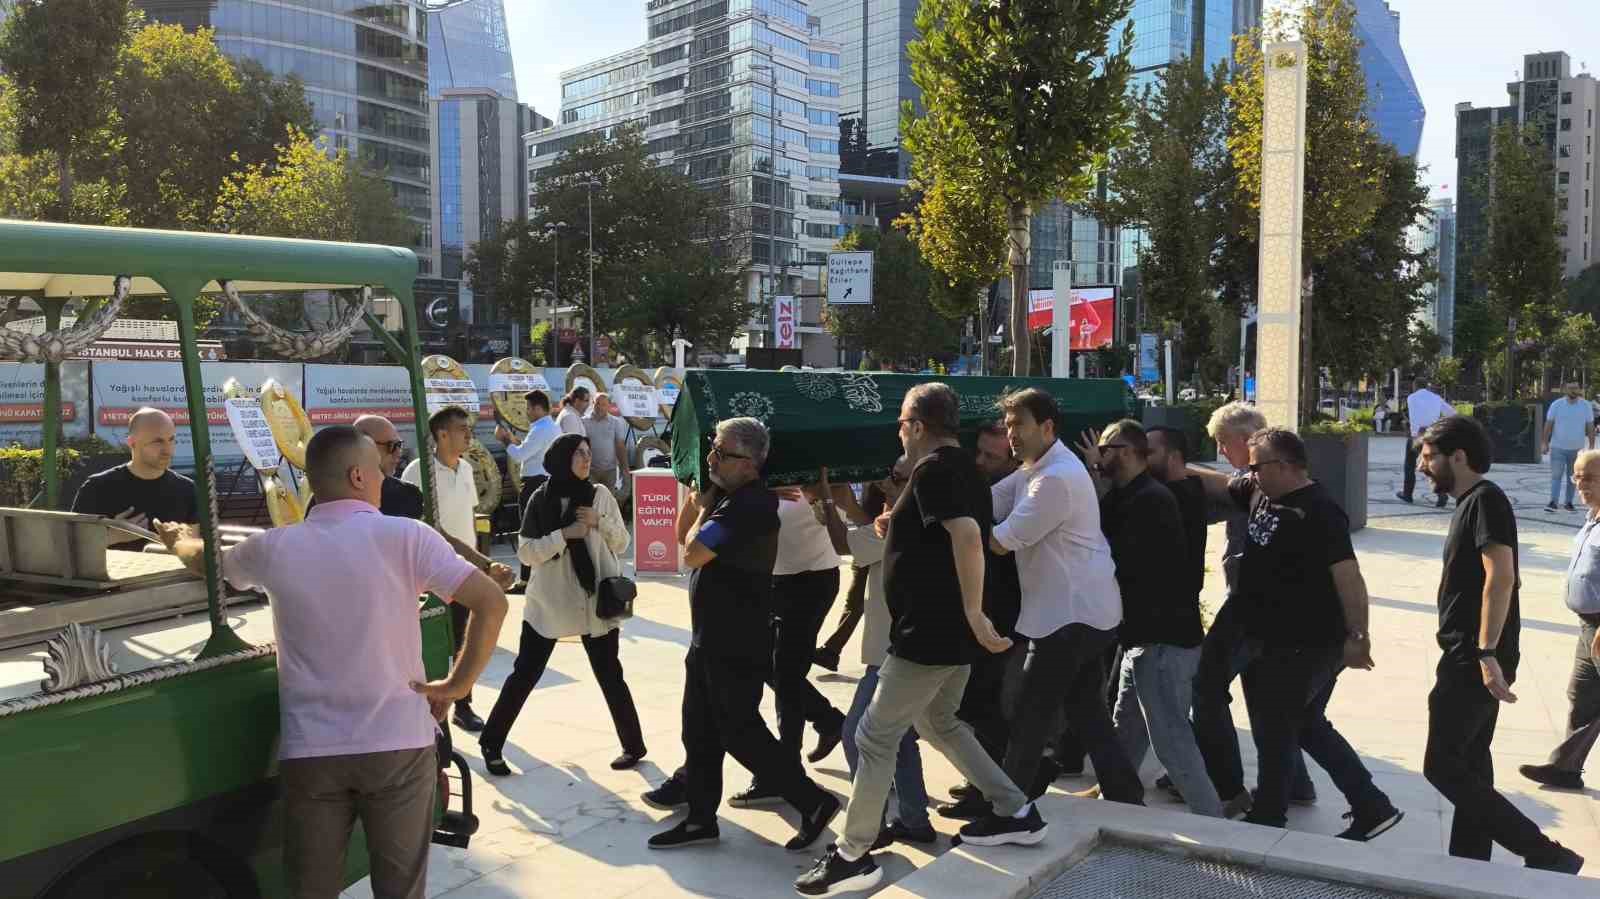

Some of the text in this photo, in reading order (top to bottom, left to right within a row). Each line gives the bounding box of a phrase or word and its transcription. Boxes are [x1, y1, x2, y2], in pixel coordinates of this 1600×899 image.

[78, 348, 132, 358] STANBUL
[135, 349, 164, 359] HALK
[641, 493, 672, 502] TÜRK
[637, 505, 676, 515] EĞİTİM
[641, 518, 673, 527] VAKFI
